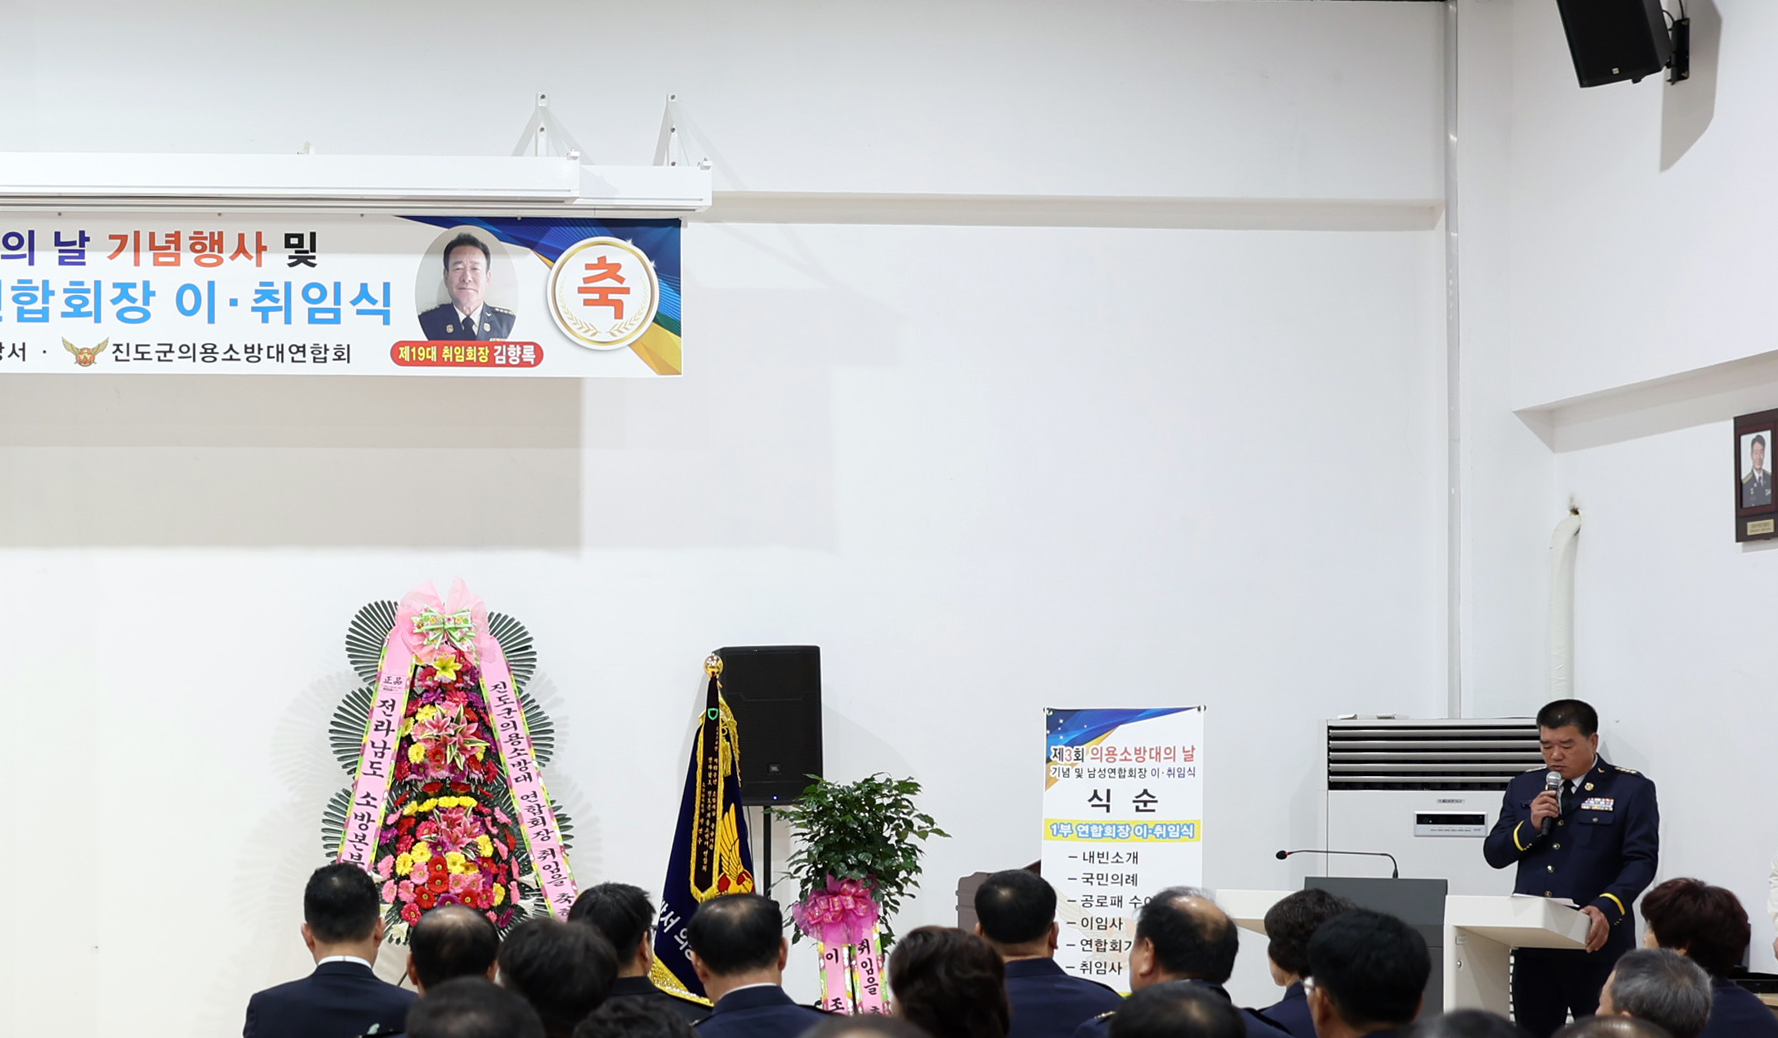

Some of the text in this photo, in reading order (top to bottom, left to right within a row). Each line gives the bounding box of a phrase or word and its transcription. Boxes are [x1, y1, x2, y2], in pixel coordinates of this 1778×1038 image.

[53, 230, 91, 266] 날
[108, 231, 268, 268] 기념행사
[283, 232, 318, 268] 및
[577, 254, 631, 320] 축
[175, 280, 391, 326] 이·취임식
[111, 339, 351, 365] 진도군의용소방대연합회
[398, 344, 537, 365] 제19대 취임회장 김향록
[362, 698, 397, 779] 전라남도
[490, 680, 534, 784] 진도군의용소방대
[1051, 744, 1196, 763] 제3회 의용소방대의 날
[1051, 766, 1196, 780] 기념 및 남성연합회장 이·취임식
[1087, 788, 1159, 814] 식 순
[520, 790, 555, 842] 연합회장
[1050, 823, 1195, 839] 1부 연합회장 이·취임식
[537, 848, 568, 888] 취임을
[1082, 850, 1139, 865] 내빈소개
[1081, 872, 1138, 887] 국민의례
[1081, 894, 1123, 909] 공로패
[1081, 917, 1123, 931] 이임사
[857, 937, 880, 996] 취임을
[1080, 961, 1123, 975] 취임사
